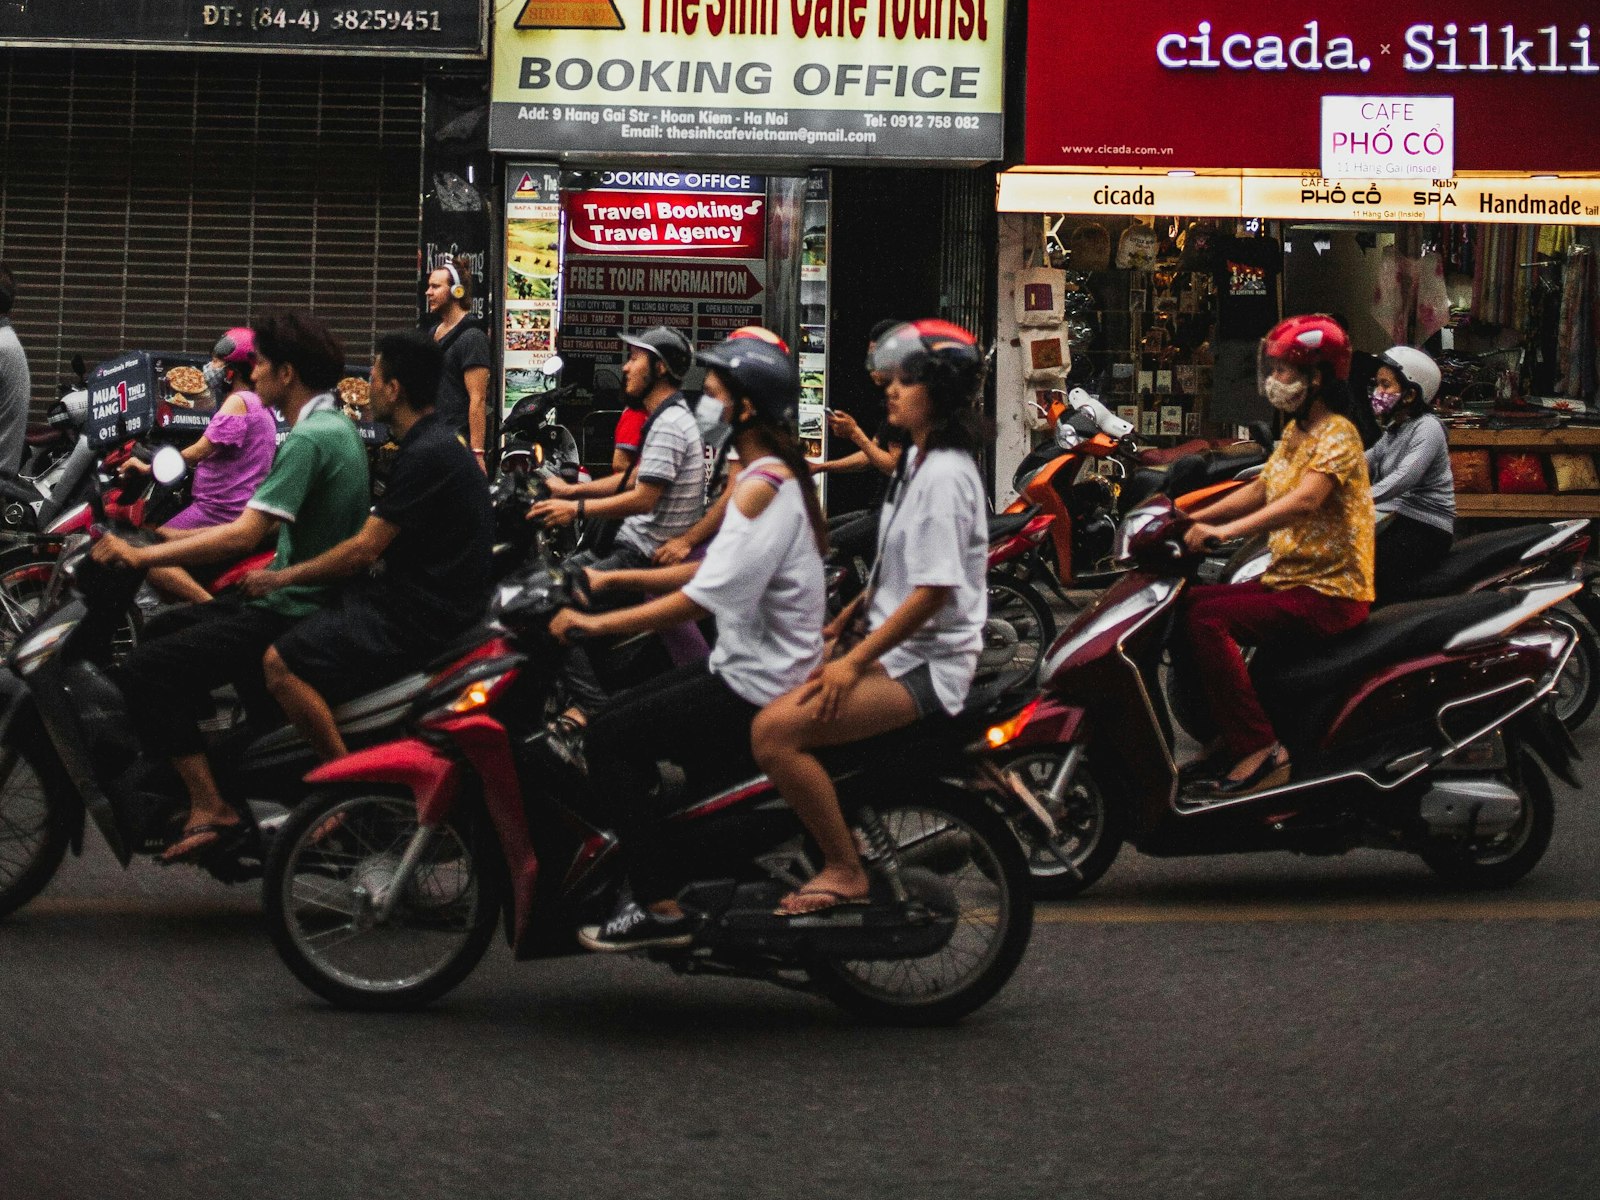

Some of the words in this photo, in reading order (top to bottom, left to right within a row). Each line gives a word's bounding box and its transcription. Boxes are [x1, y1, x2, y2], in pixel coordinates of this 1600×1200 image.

[201, 5, 244, 28] ĐT:
[250, 6, 320, 32] (84-4)
[329, 8, 442, 32] 38259451
[1155, 20, 1372, 73] cicada.
[1402, 23, 1600, 73] Silkli
[518, 56, 773, 95] BOOKING
[793, 62, 981, 99] OFFICE
[517, 106, 549, 121] Add:
[552, 107, 562, 121] 9
[564, 108, 600, 125] Hang
[602, 108, 626, 122] Gai
[628, 108, 650, 123] Str
[660, 110, 695, 124] Hoan
[699, 110, 733, 125] Kiem
[743, 111, 763, 125] Ha
[765, 111, 789, 126] Noi
[863, 113, 887, 128] Tel:
[890, 114, 923, 128] 0912
[926, 115, 952, 129] 758
[954, 116, 980, 130] 082
[1361, 102, 1415, 121] CAFE
[620, 124, 663, 139] Email:
[666, 125, 877, 144] thesinhcafevietnam@gmail.com
[1332, 123, 1393, 156] PHỐ
[1403, 123, 1444, 156] CỔ
[1061, 144, 1174, 155] www.cicada.com.vn
[602, 171, 681, 187] OOKING
[684, 173, 751, 189] OFFICE
[1301, 178, 1330, 188] CAFE
[1432, 178, 1458, 190] Ruby
[1093, 184, 1155, 206] cicada
[1301, 182, 1346, 204] PHỐ
[1352, 182, 1382, 205] CỔ
[1413, 191, 1457, 206] SPA
[583, 202, 652, 221] Travel
[656, 201, 744, 221] Booking
[1480, 192, 1582, 216] Handmade
[1585, 206, 1599, 216] tail
[589, 223, 659, 242] Travel
[664, 223, 743, 243] Agency
[569, 266, 605, 290] FREE
[608, 267, 646, 292] TOUR
[92, 385, 119, 406] MUA
